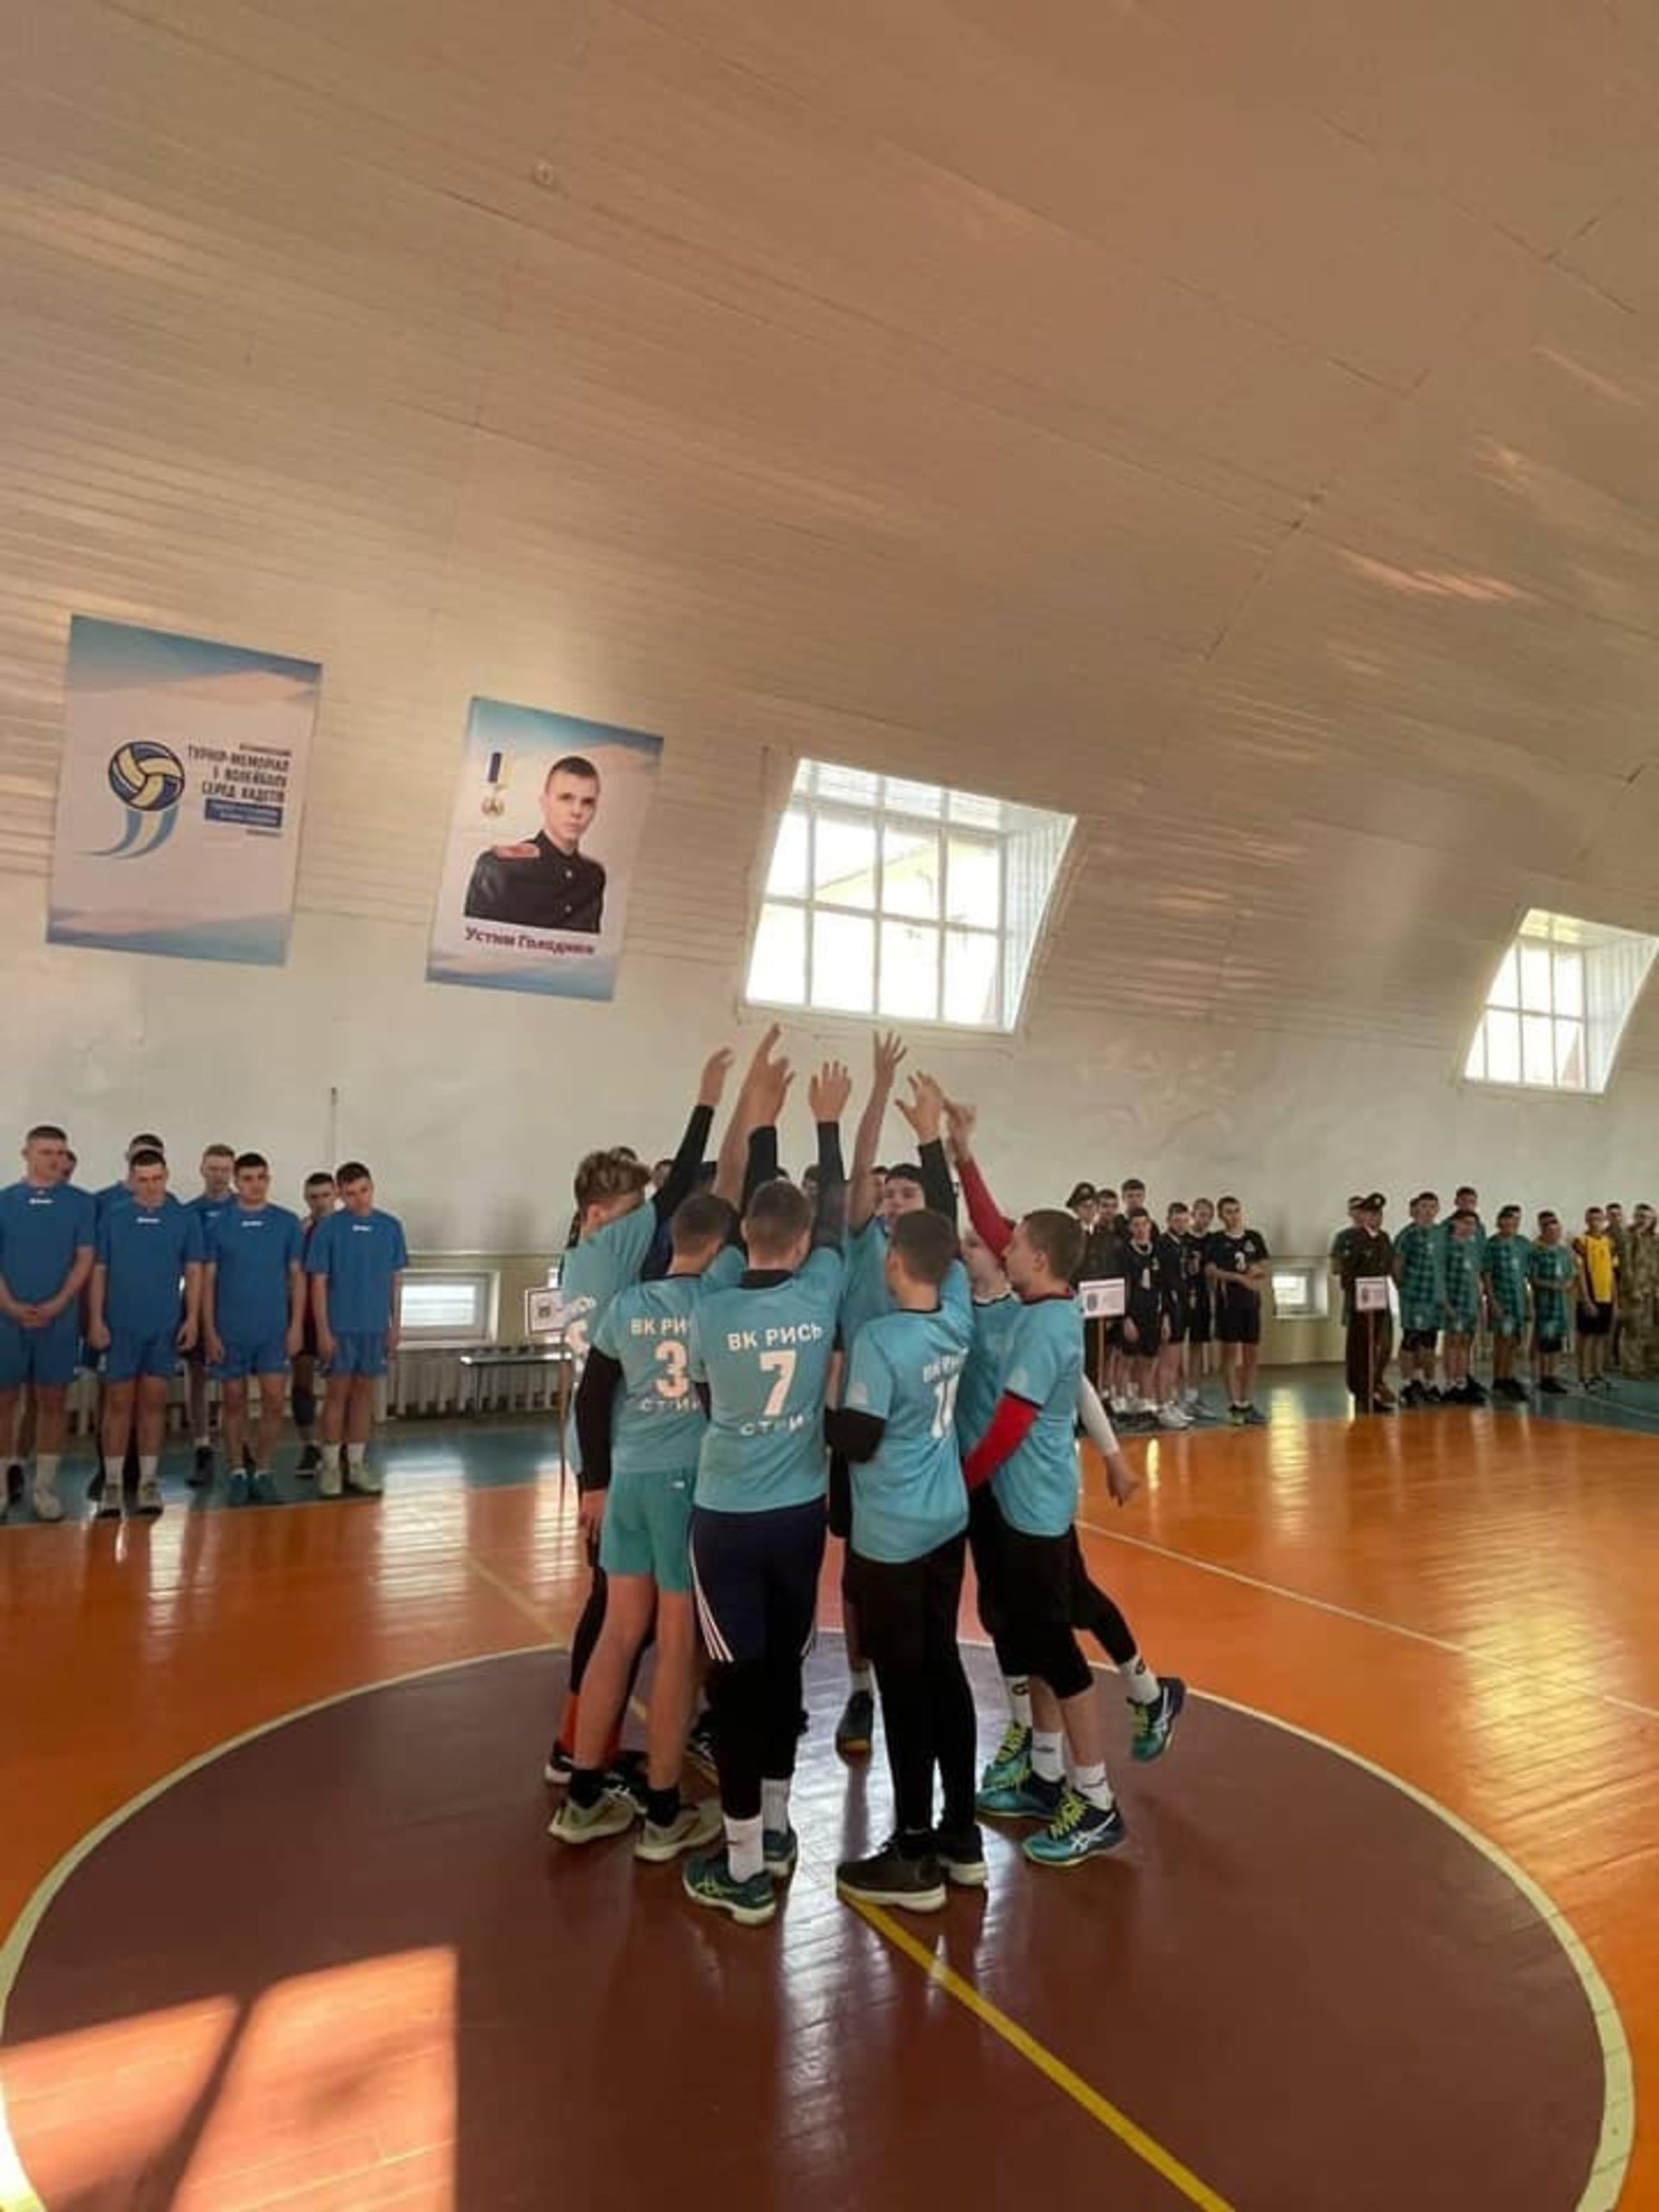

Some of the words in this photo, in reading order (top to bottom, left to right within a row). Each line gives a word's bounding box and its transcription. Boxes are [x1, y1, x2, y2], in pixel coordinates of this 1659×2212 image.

[631, 1318, 657, 1336] ВК
[661, 1318, 688, 1337] РИ
[728, 1331, 759, 1351] ВК
[766, 1322, 823, 1346] РИСЬ
[655, 1340, 689, 1397] 3
[760, 1350, 796, 1416] 7
